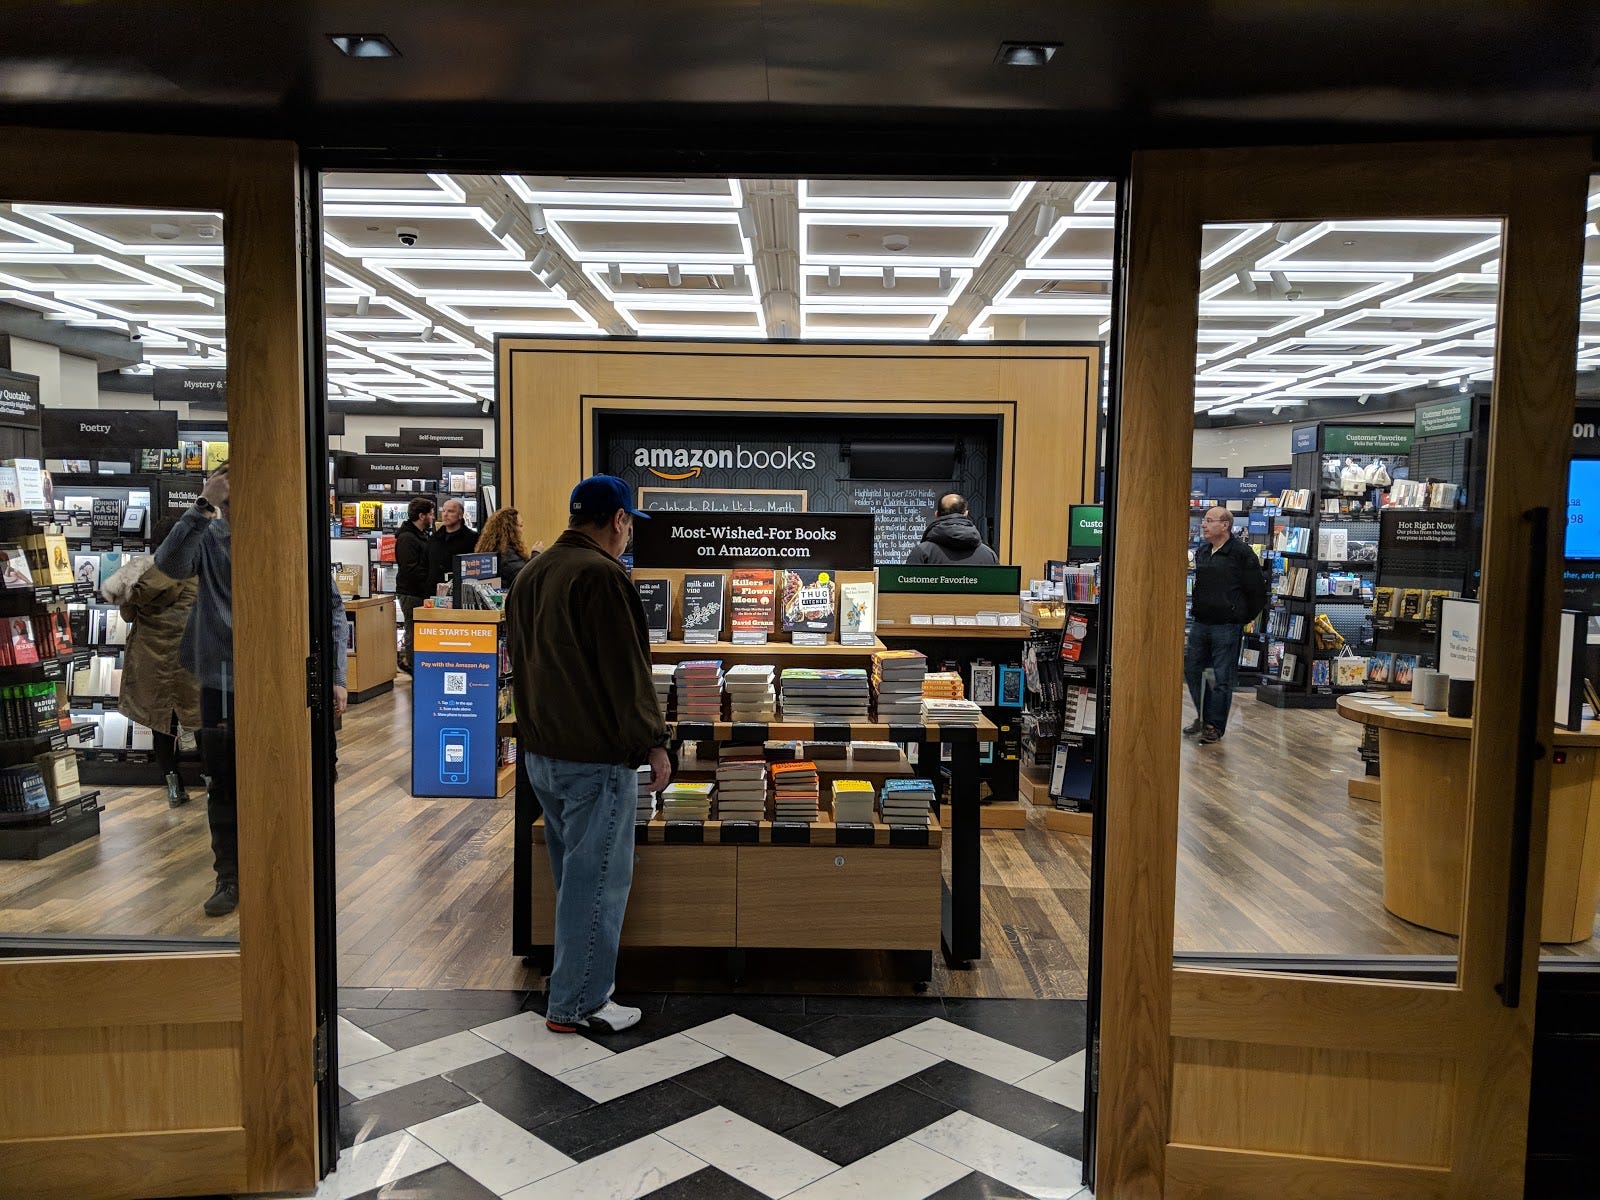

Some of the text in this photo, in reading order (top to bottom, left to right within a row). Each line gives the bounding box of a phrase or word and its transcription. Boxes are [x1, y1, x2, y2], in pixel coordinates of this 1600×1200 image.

[184, 380, 215, 390] Mystery
[3, 390, 31, 401] Quotable
[80, 423, 111, 434] Poetry
[634, 445, 816, 470] amazon books
[169, 491, 178, 499] Book
[179, 491, 188, 499] Club
[884, 489, 891, 499] by
[928, 498, 935, 508] by
[94, 505, 119, 513] CASH
[1080, 519, 1103, 528] Custo
[1398, 521, 1413, 529] Hot
[1414, 521, 1435, 530] Right
[670, 526, 837, 540] Most-Wished-For Books
[697, 545, 811, 557] on Amazon.com
[1581, 571, 1594, 579] and
[898, 576, 978, 584] Customer Favorites
[801, 590, 828, 598] THUG
[439, 628, 469, 636] STARTS
[471, 629, 492, 637] HERE
[34, 699, 56, 707] RADIUM
